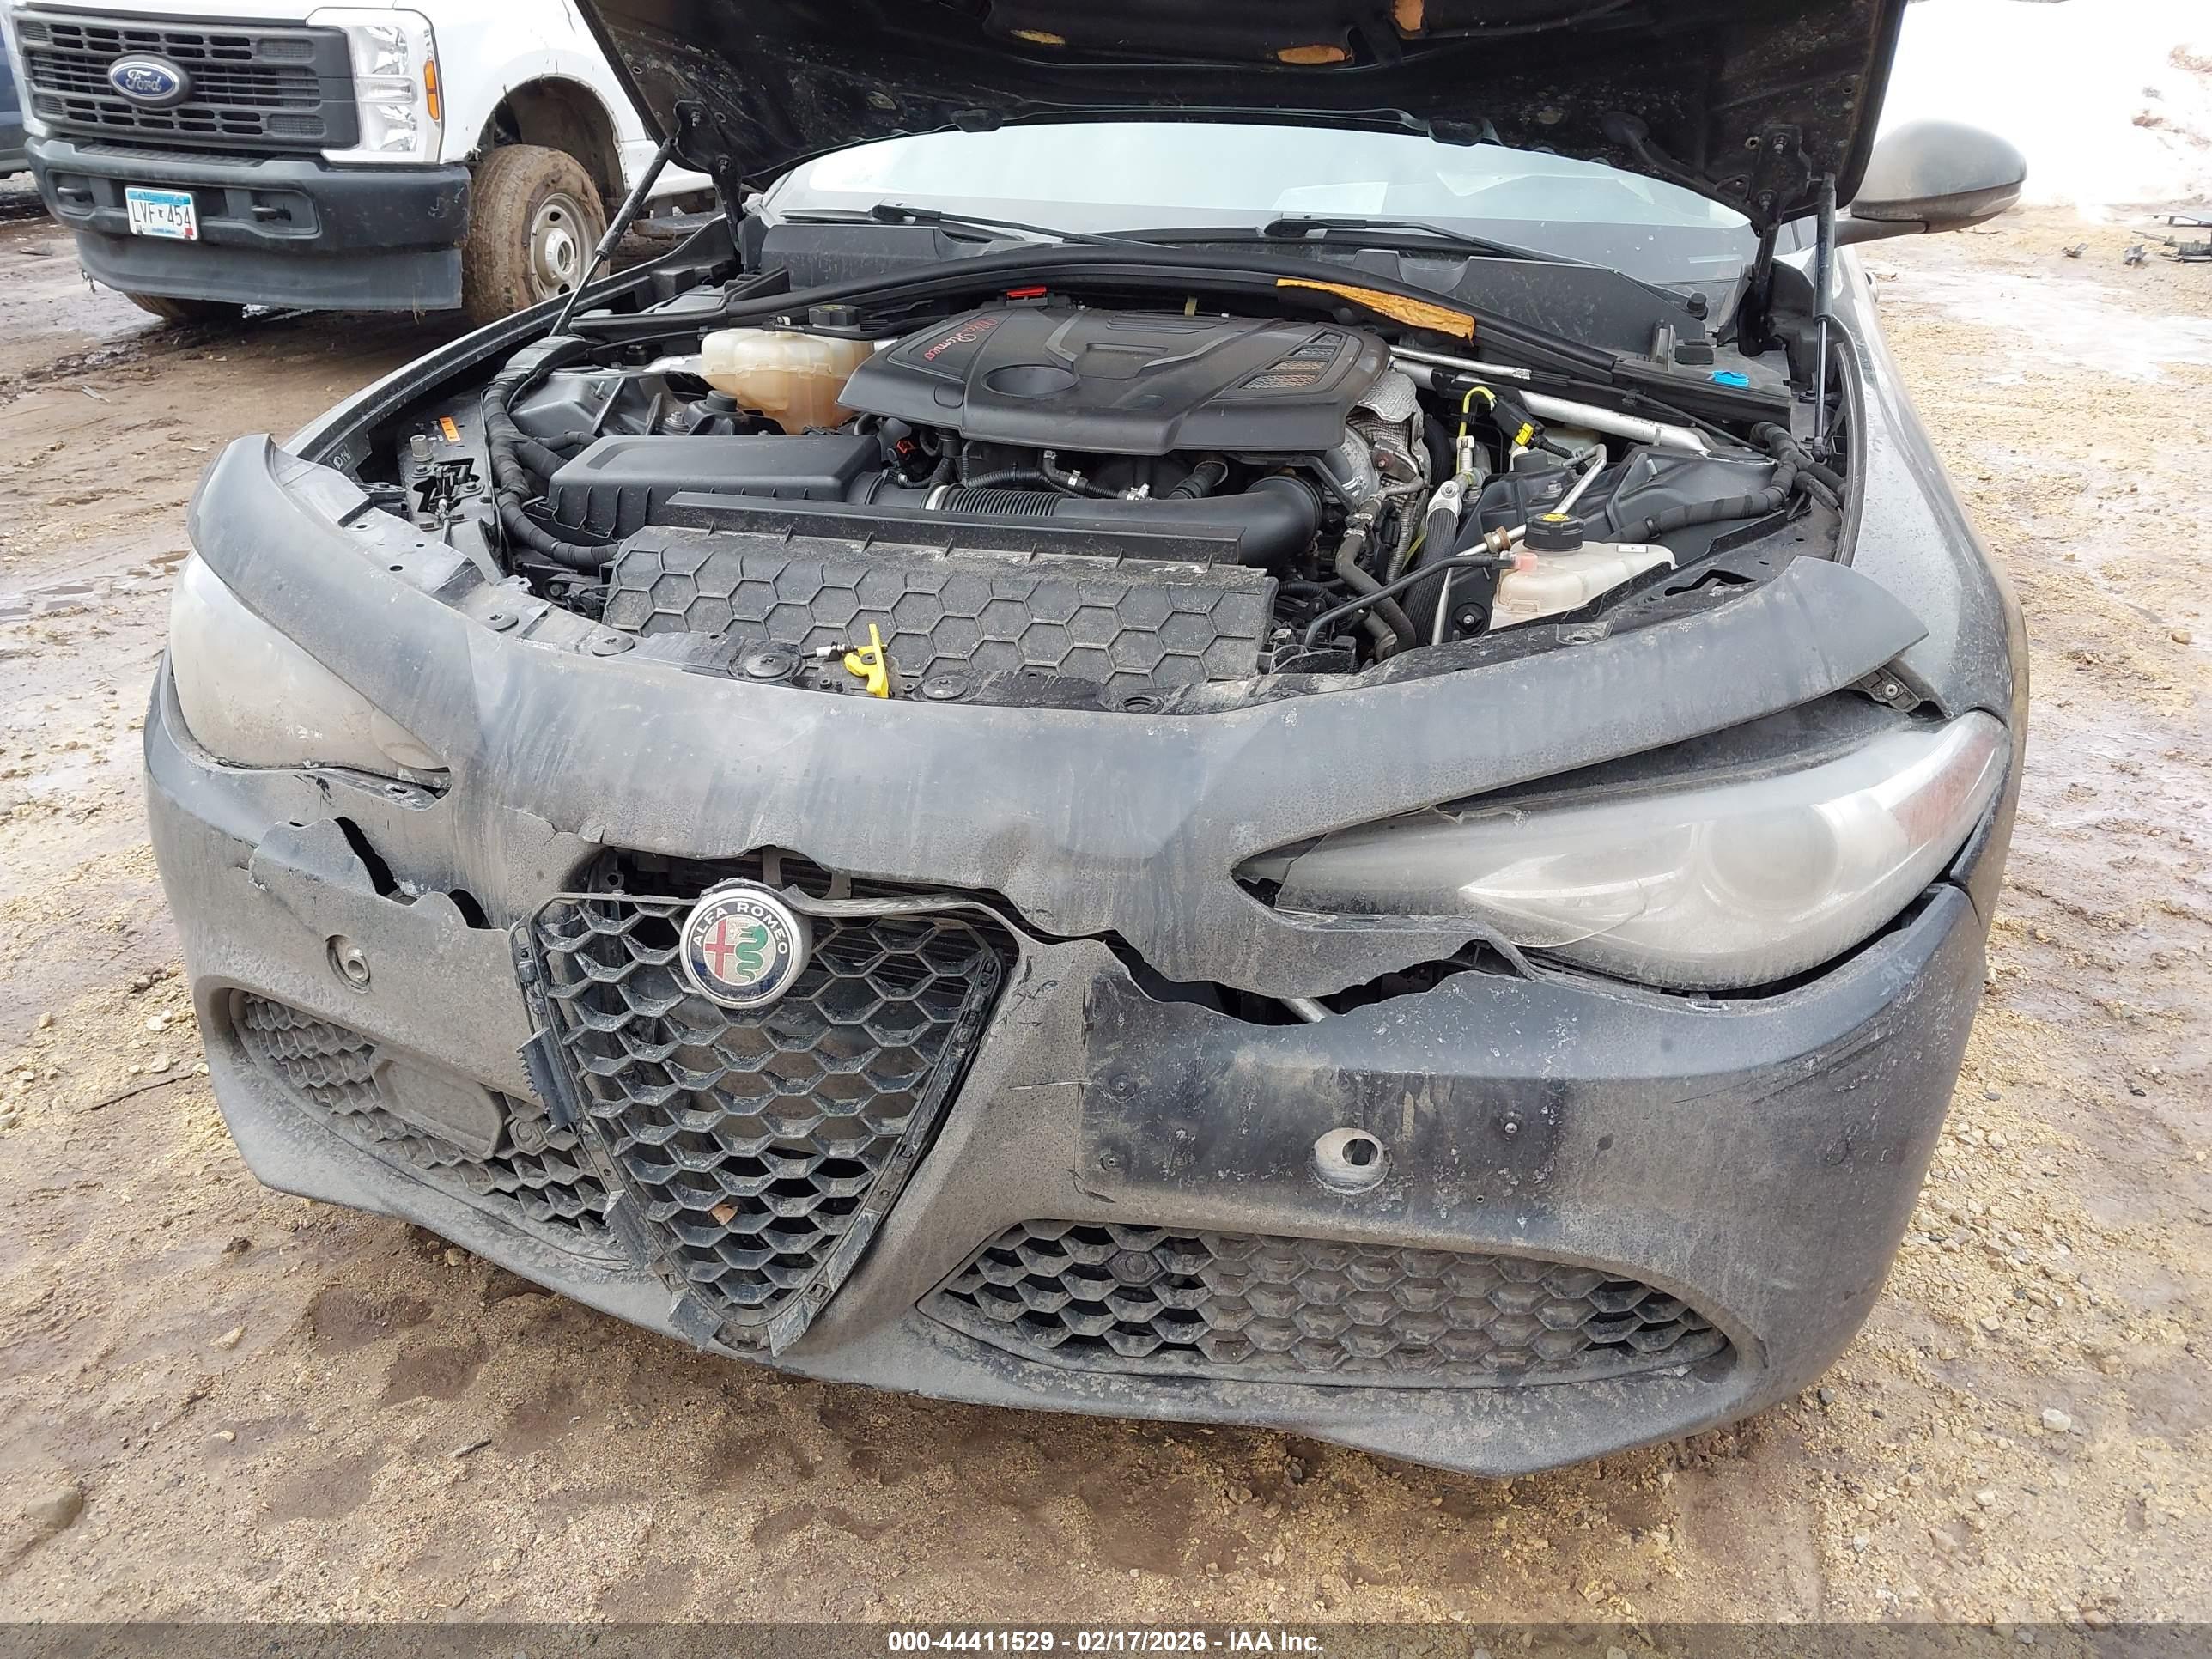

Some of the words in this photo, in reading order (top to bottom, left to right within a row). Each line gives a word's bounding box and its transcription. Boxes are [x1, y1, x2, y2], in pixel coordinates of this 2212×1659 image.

[125, 69, 161, 92] Ford
[131, 201, 155, 223] LVF
[167, 204, 191, 228] 454
[924, 332, 977, 362] Romeo
[692, 907, 729, 947] ALFA
[736, 902, 788, 955] ROMEO
